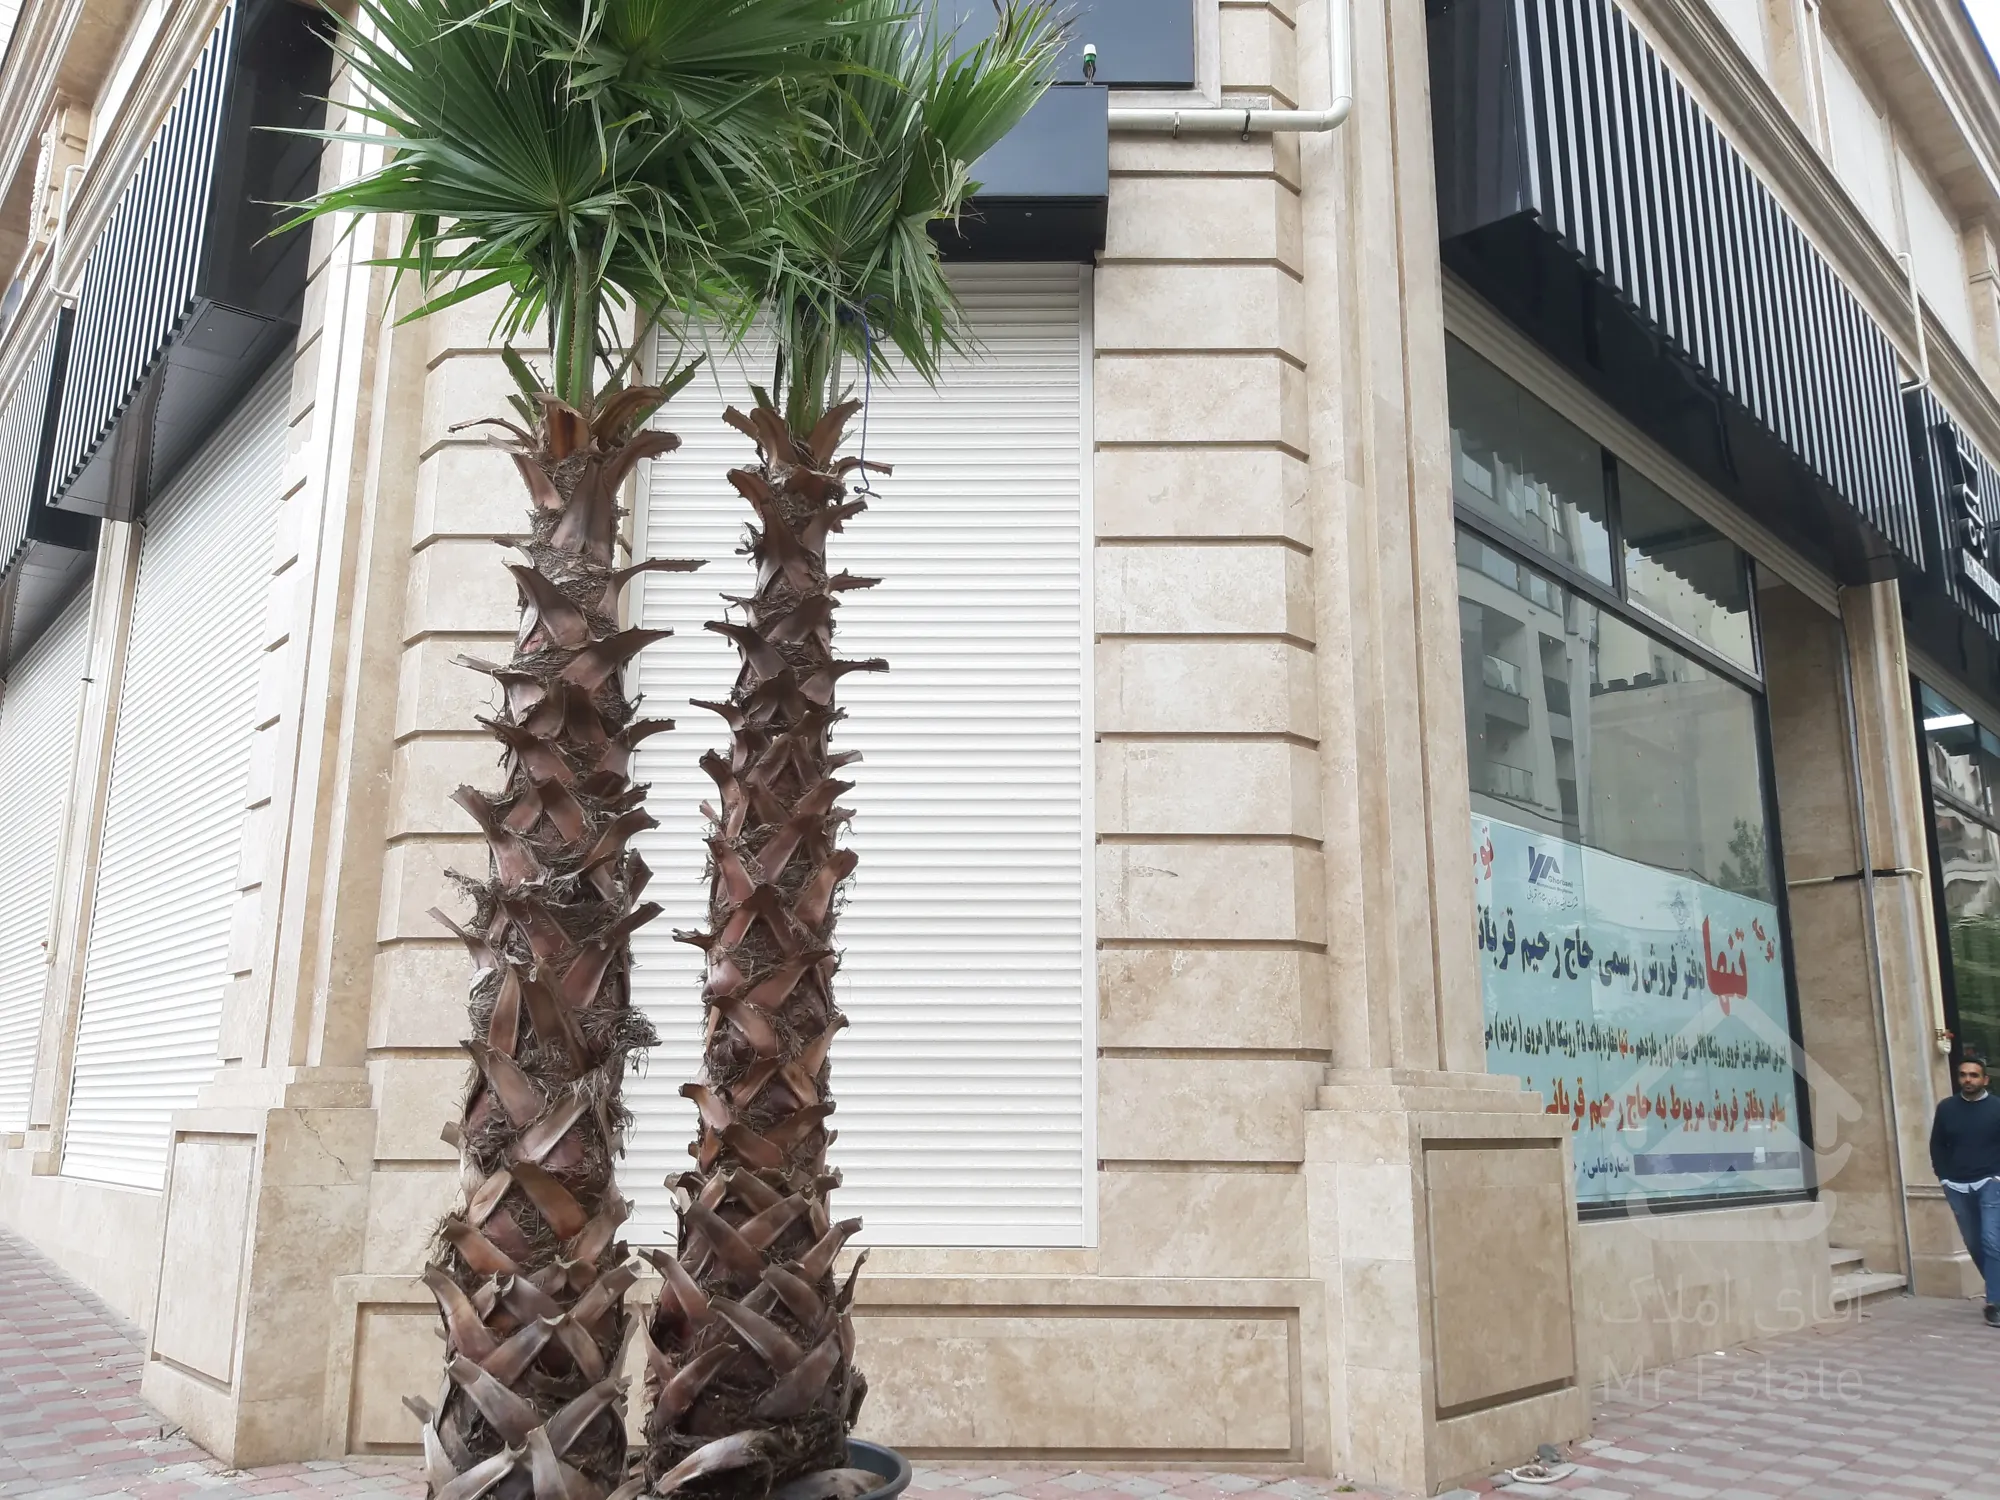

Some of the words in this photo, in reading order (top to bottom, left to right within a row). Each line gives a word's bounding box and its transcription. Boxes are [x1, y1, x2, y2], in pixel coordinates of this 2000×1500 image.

[1473, 826, 1494, 884] تو
[1478, 903, 1516, 970] قربان
[1521, 931, 1561, 979] رحیم
[1564, 925, 1594, 980] حاج
[1752, 917, 1776, 963] توجه
[1599, 951, 1639, 992] رسمی
[1642, 943, 1678, 998] فروش
[1682, 949, 1705, 1000] دفتر
[1702, 915, 1748, 1016] تنها
[1544, 1017, 1555, 1054] مال
[1617, 1027, 1629, 1060] تنها
[1590, 1092, 1624, 1131] رحیم
[1626, 1081, 1652, 1130] حاج
[1655, 1091, 1667, 1130] به
[1670, 1084, 1705, 1132] مربوط
[1708, 1087, 1739, 1132] فروش
[1743, 1088, 1765, 1132] دفاتر
[1769, 1091, 1787, 1132] سایر
[1587, 1157, 1608, 1179] تماس
[1610, 1156, 1630, 1178] شماره
